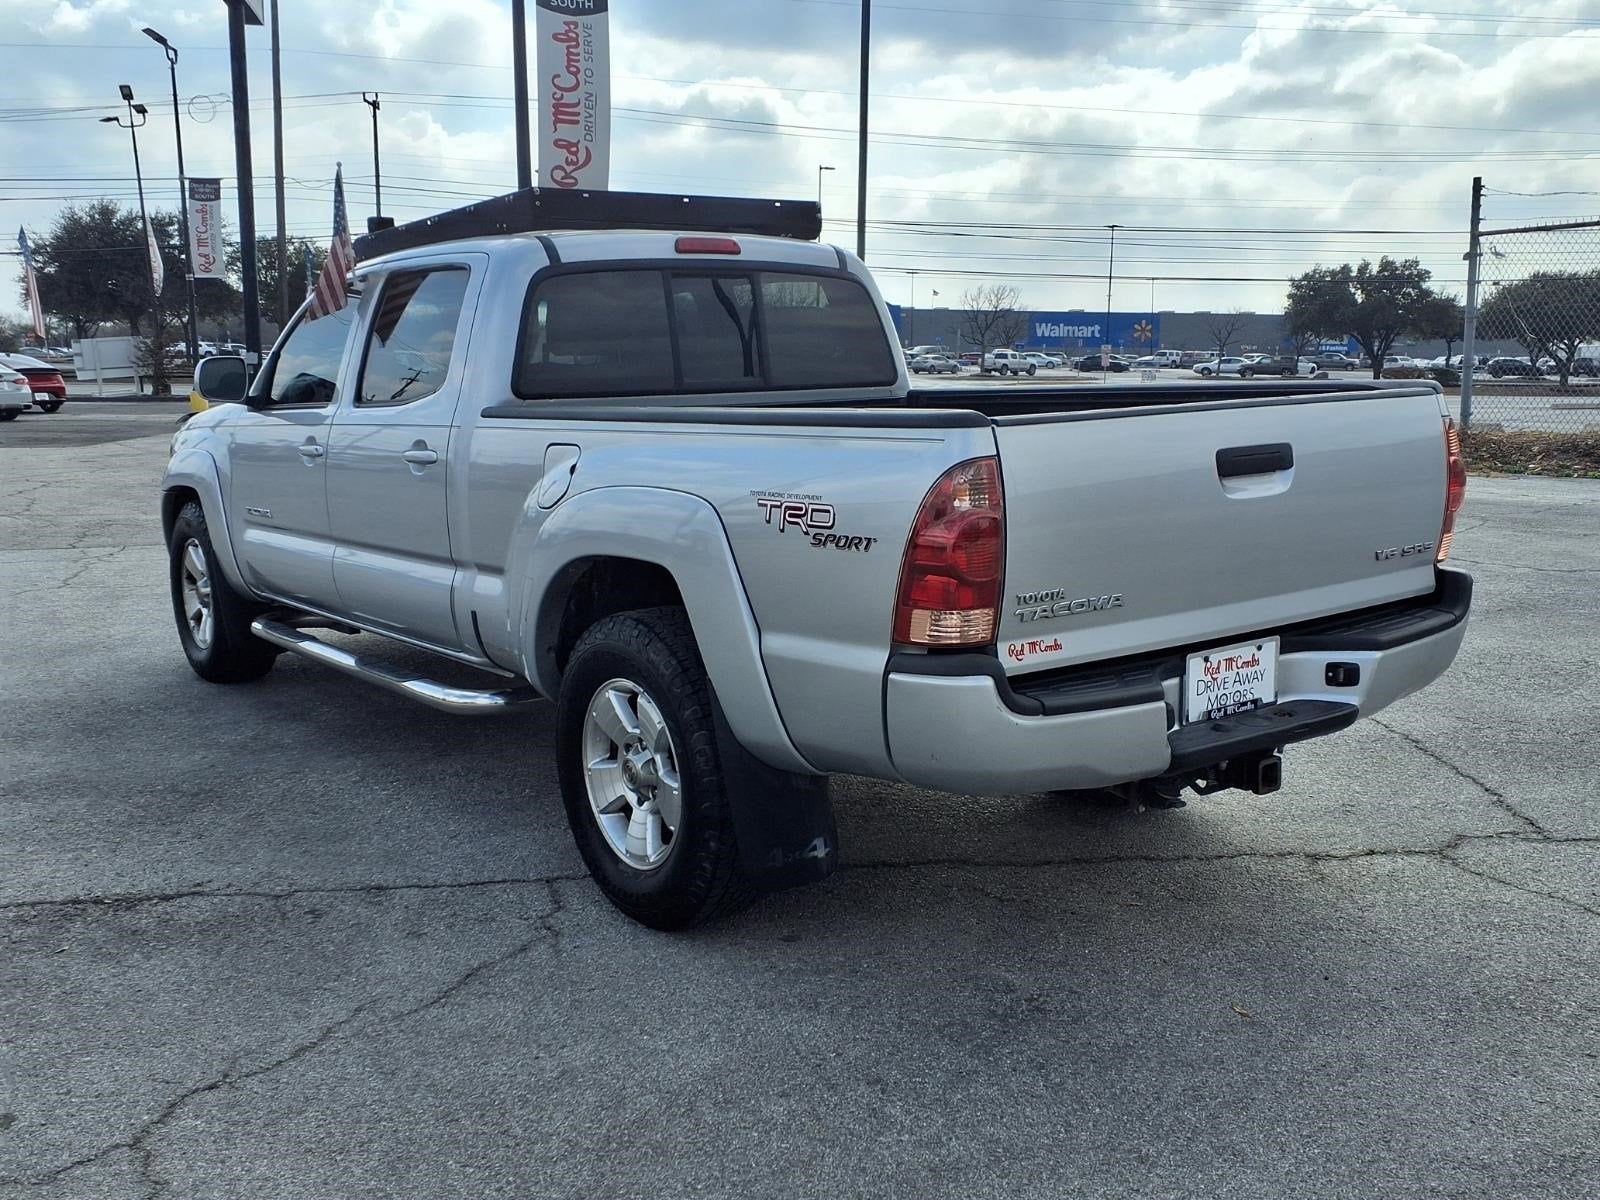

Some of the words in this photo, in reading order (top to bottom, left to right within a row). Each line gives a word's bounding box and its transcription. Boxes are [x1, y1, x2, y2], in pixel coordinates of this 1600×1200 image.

[550, 0, 594, 9] SOUTH
[583, 22, 594, 63] SERVE
[552, 20, 581, 133] McCombs
[583, 69, 595, 86] TO
[583, 92, 595, 143] DRIVEN
[550, 138, 592, 188] Red
[195, 203, 209, 251] McCombs
[198, 252, 216, 273] Red
[1035, 322, 1101, 338] Walmart
[768, 491, 786, 499] RACING
[787, 493, 823, 501] DEVELOPMENT
[757, 498, 836, 536] TRD
[810, 532, 876, 553] SPORT
[1014, 593, 1124, 623] TACOMA
[1015, 588, 1066, 606] TOYOTA
[1008, 642, 1025, 661] Red
[1026, 638, 1063, 655] McCombs
[1204, 660, 1221, 680] Red
[1222, 653, 1260, 673] McCombs
[1196, 676, 1230, 696] DRIVE
[1232, 668, 1266, 688] AWAY
[1206, 687, 1255, 710] MOTORS
[1210, 708, 1224, 720] Red
[1226, 701, 1255, 715] McCombs
